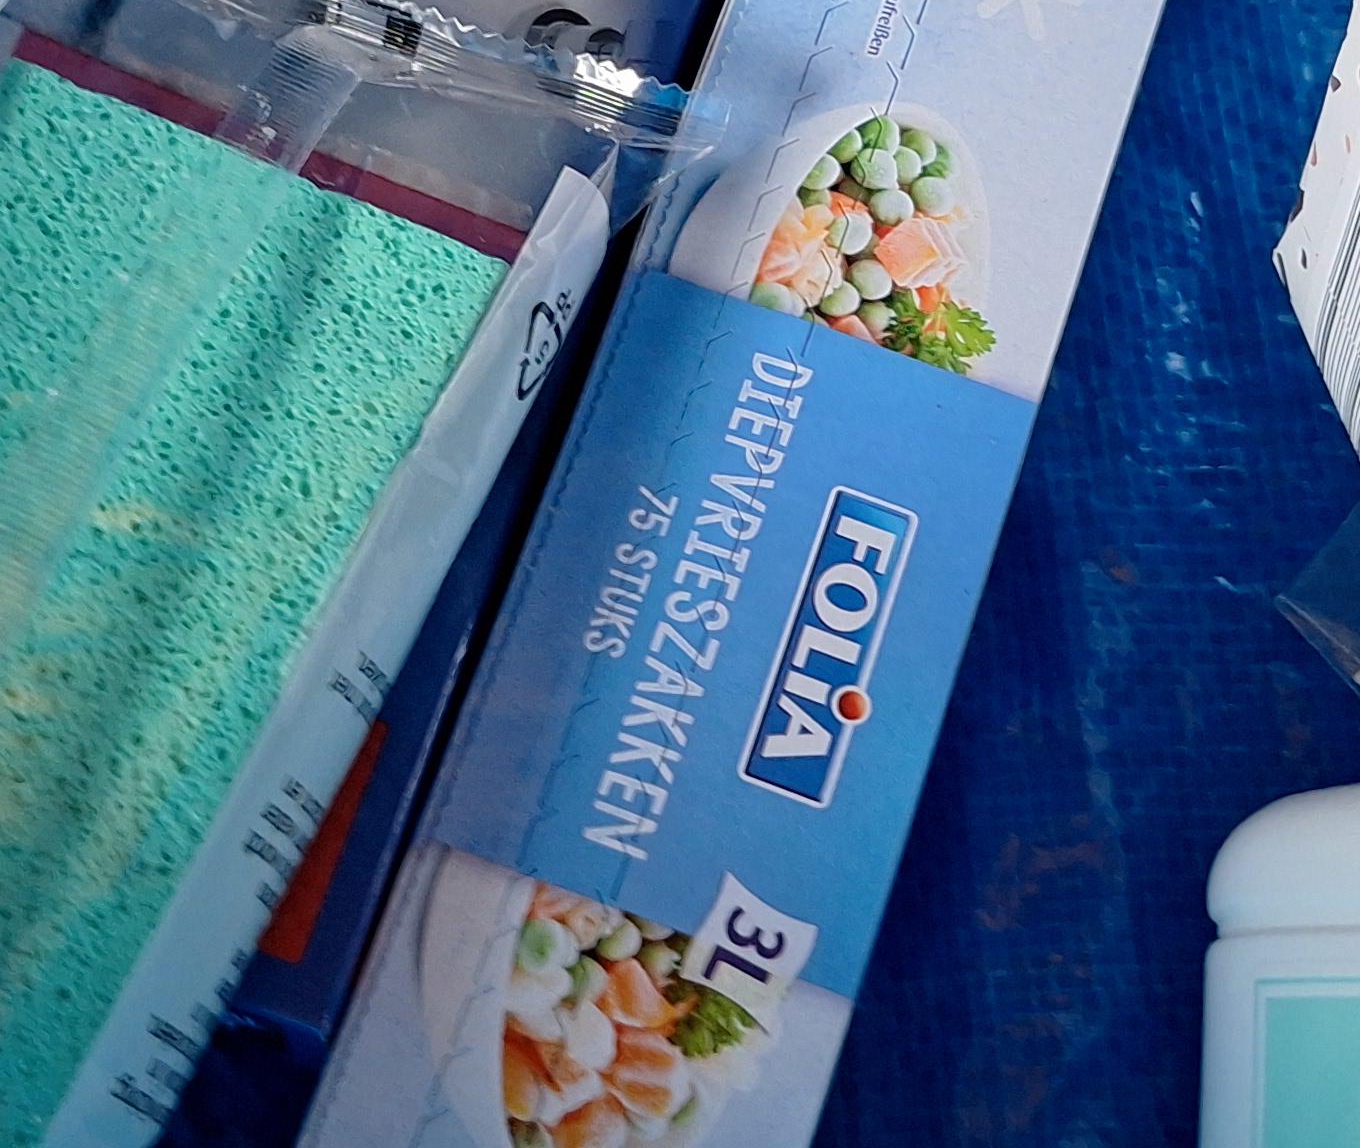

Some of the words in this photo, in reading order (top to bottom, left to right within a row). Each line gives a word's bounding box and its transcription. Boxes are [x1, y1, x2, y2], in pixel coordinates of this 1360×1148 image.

[627, 486, 677, 535] 75
[581, 541, 656, 659] STUKS
[583, 350, 808, 859] DIEPVRIESZAKKEN
[707, 908, 788, 995] 3L
